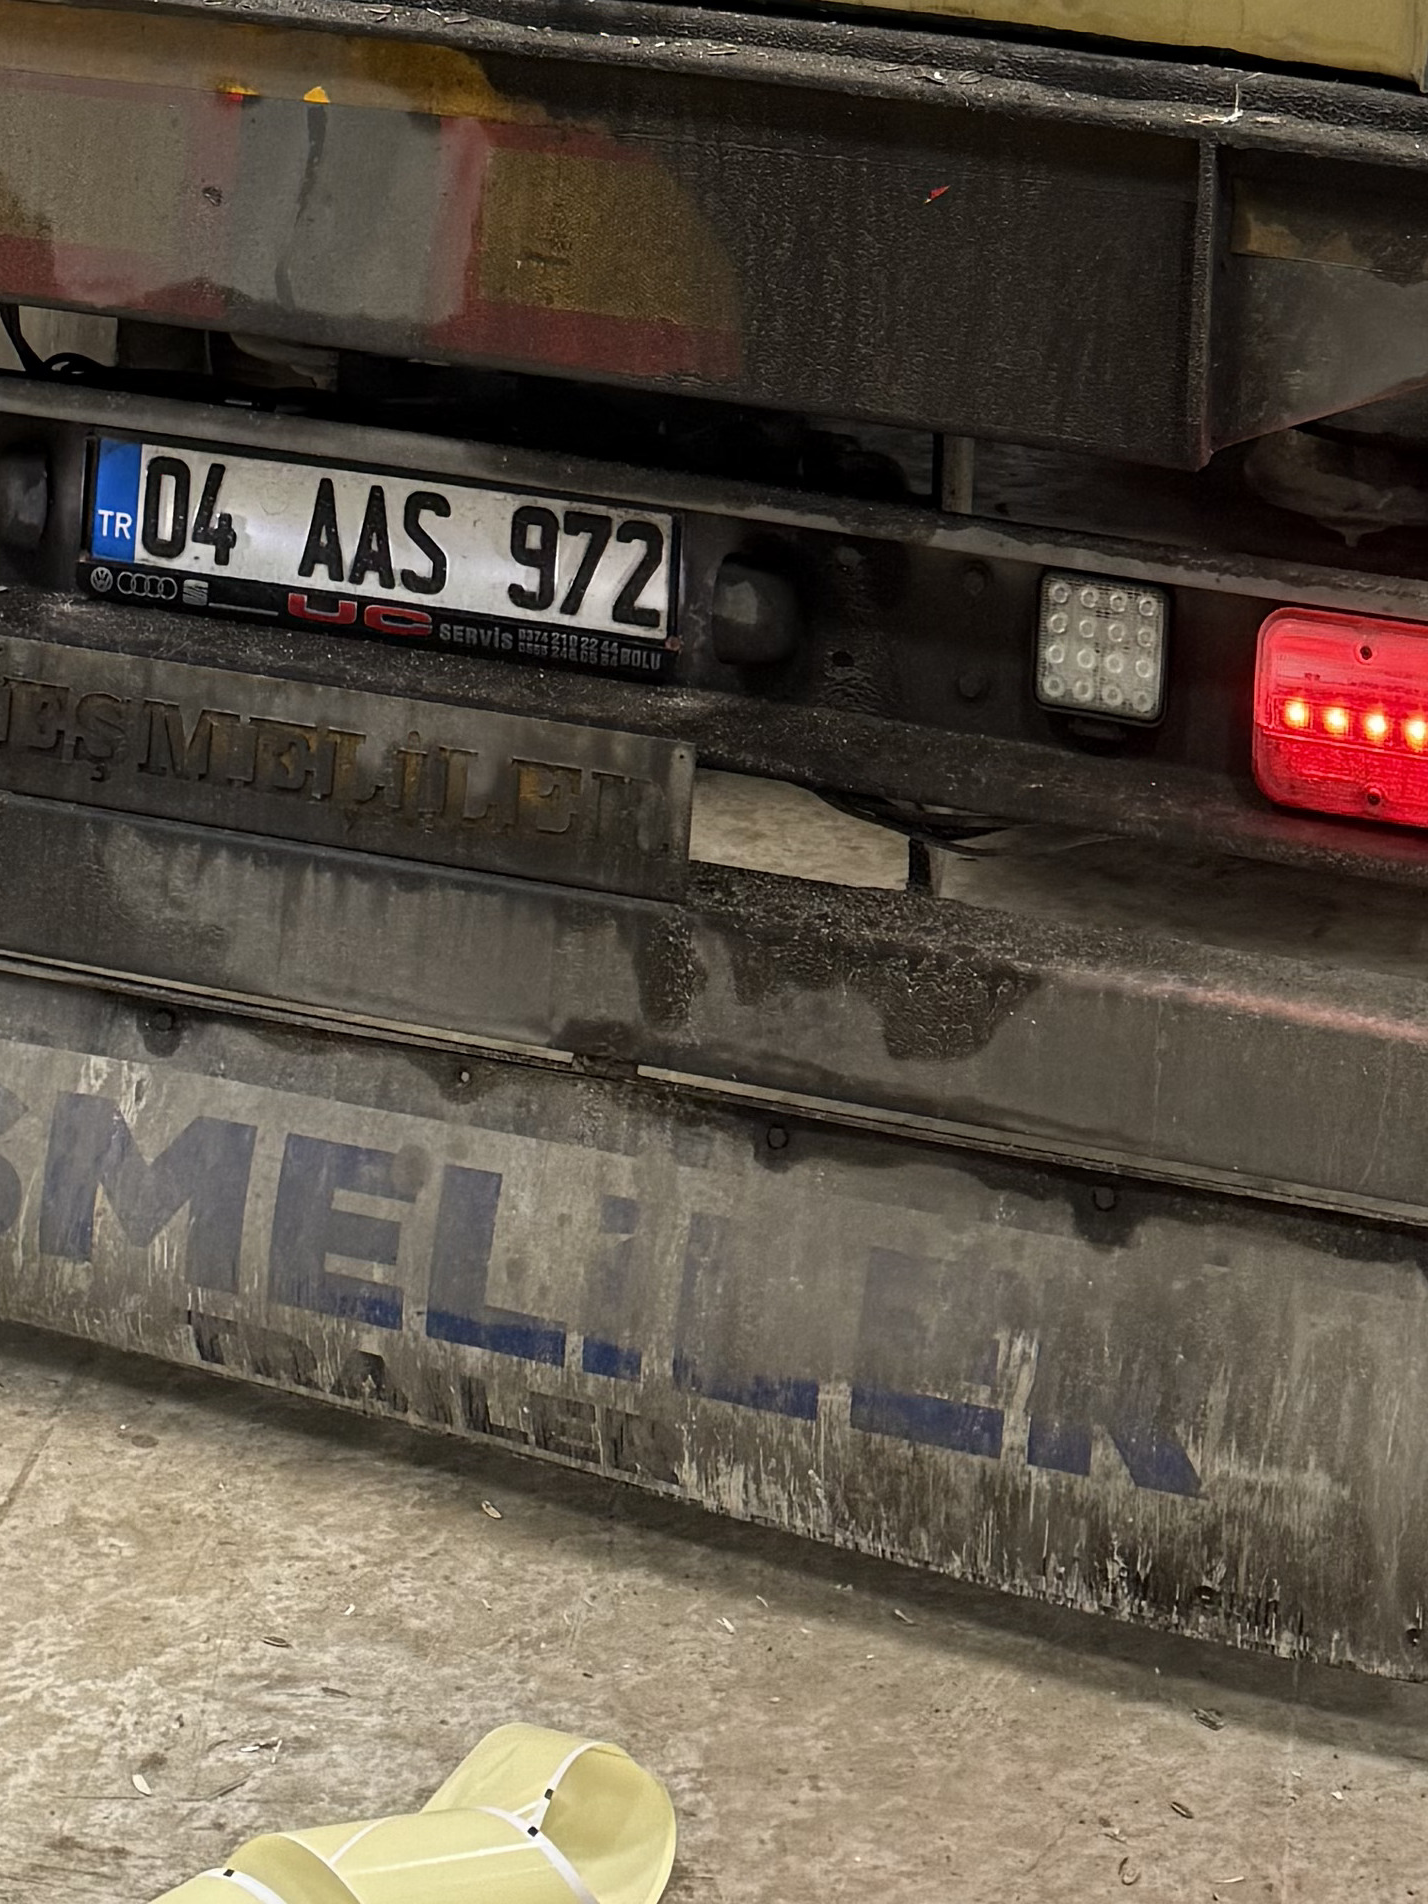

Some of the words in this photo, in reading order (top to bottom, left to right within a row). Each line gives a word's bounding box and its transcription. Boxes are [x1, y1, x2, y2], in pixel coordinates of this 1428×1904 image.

[97, 509, 133, 541] TR
[140, 455, 238, 567] 04
[298, 477, 452, 595] AAS
[507, 505, 665, 628] 972
[580, 637, 599, 651] 22
[600, 640, 619, 654] 44
[620, 648, 662, 671] BOLU
